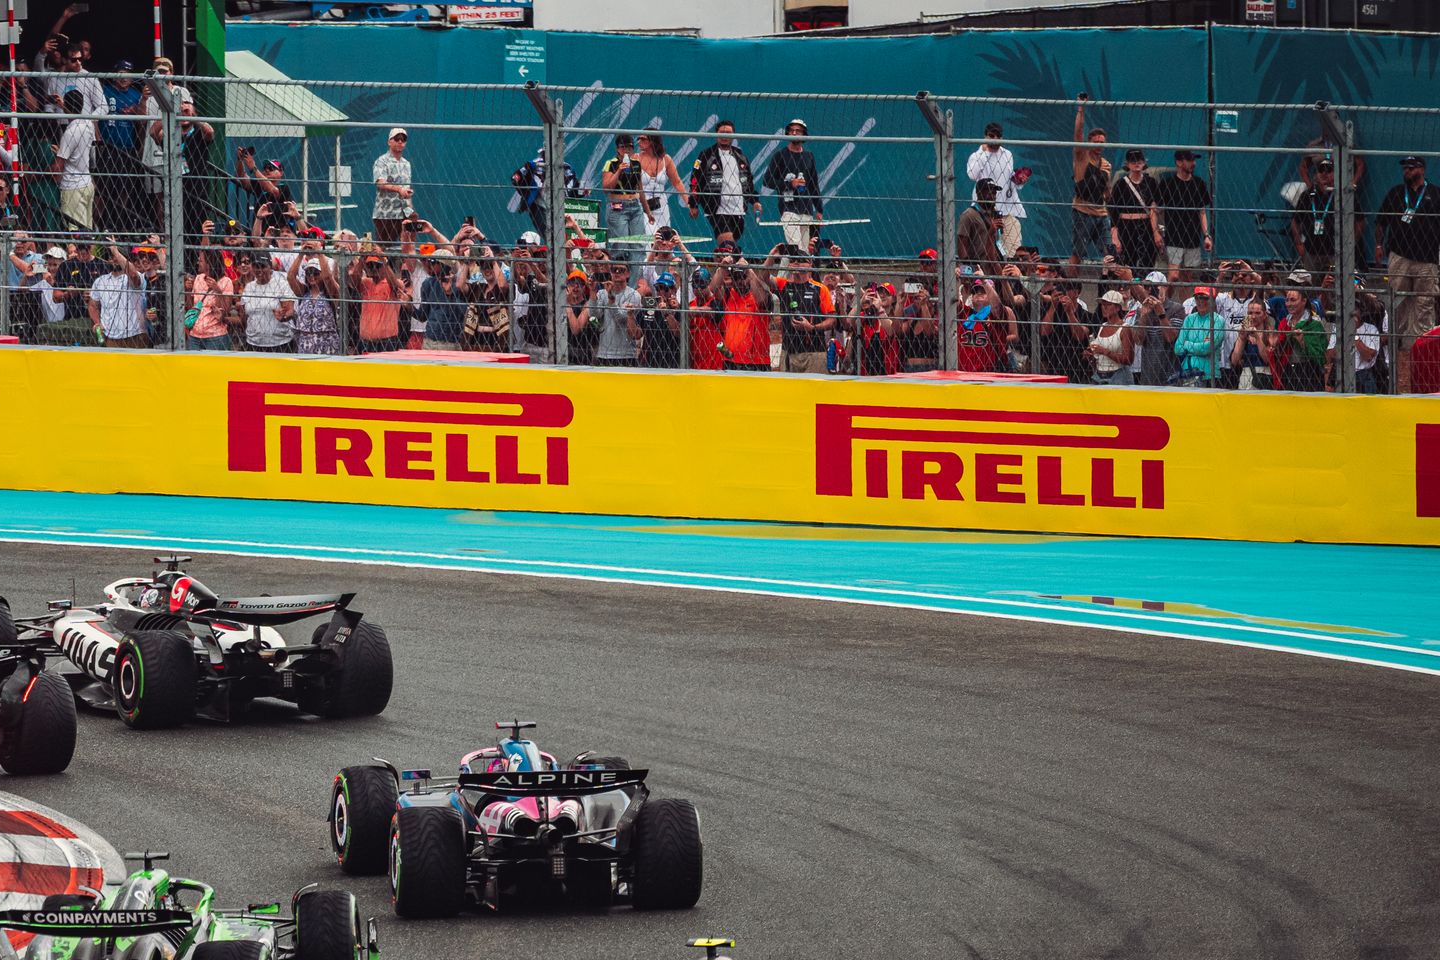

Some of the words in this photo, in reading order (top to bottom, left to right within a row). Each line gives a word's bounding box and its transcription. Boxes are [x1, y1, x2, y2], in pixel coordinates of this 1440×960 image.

[961, 331, 988, 347] 16
[228, 381, 575, 485] PIRELLI
[815, 403, 1171, 509] PIRELLI
[493, 772, 617, 785] ALPINE
[34, 912, 158, 924] COINPAYMENTS
